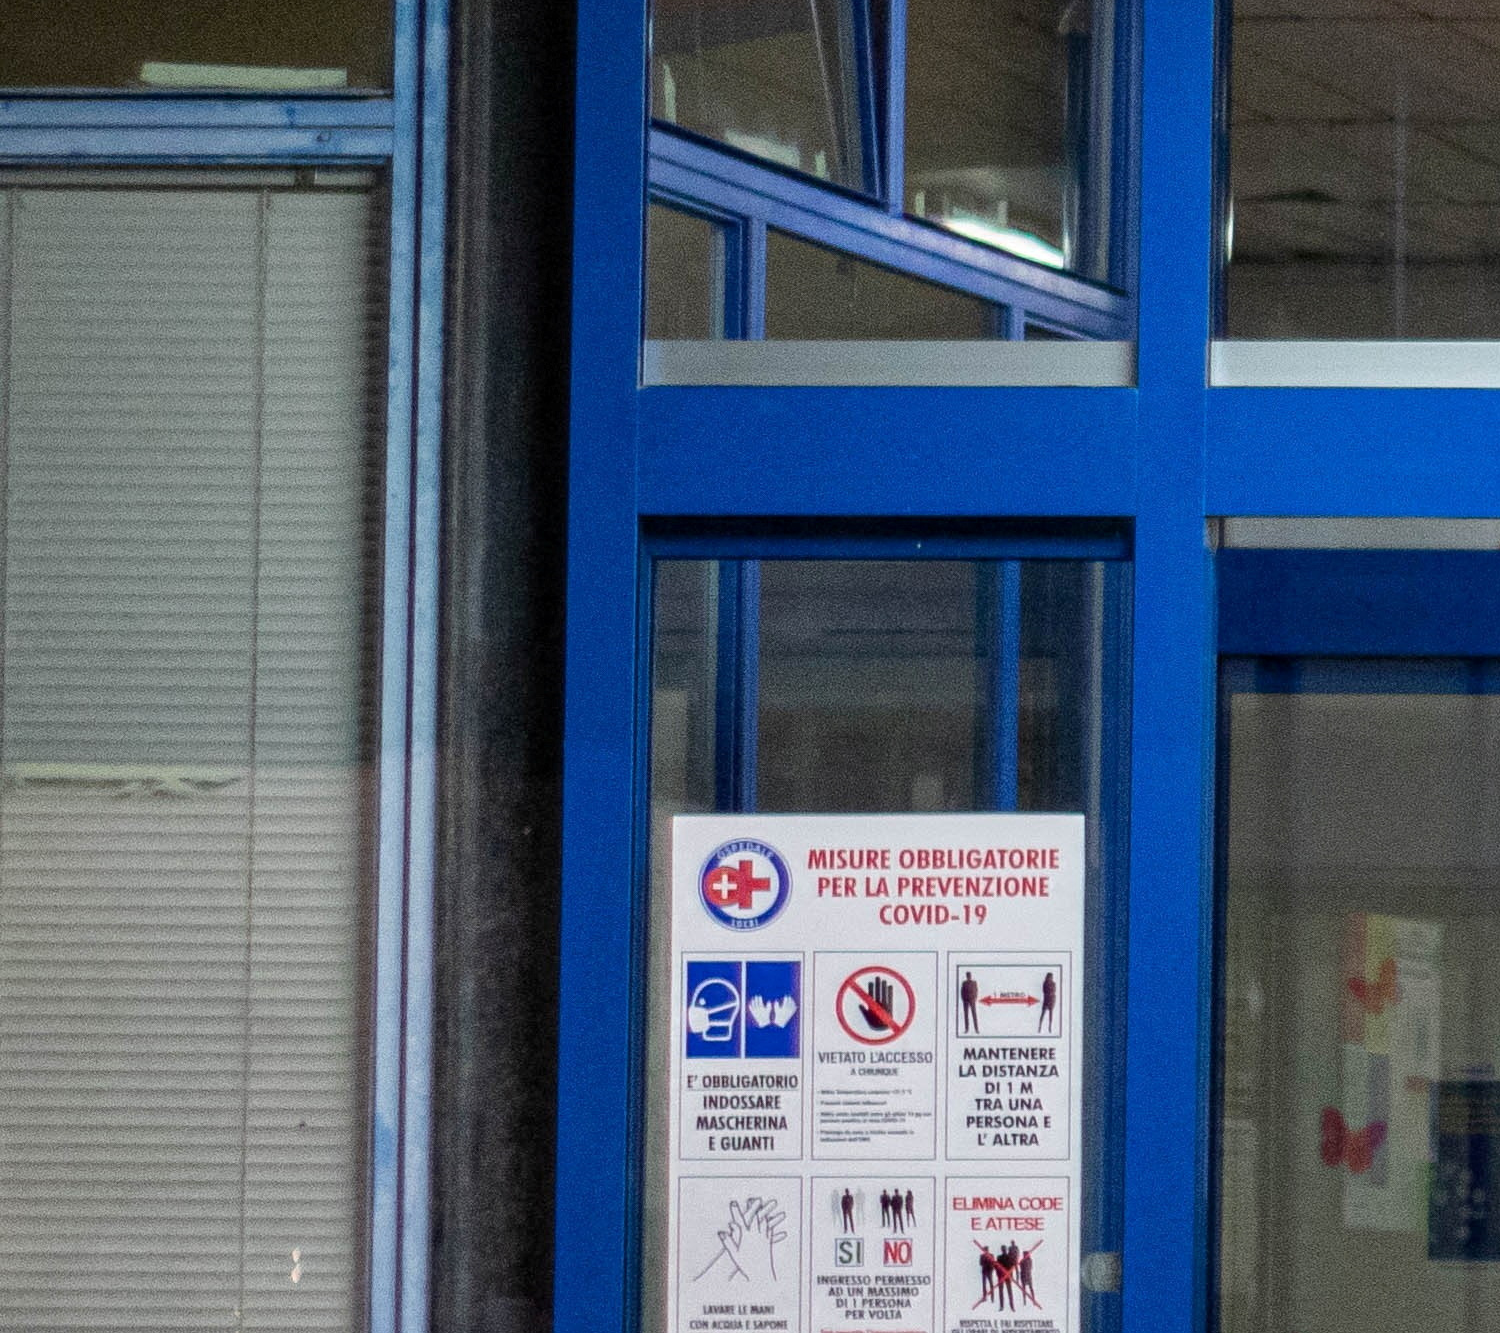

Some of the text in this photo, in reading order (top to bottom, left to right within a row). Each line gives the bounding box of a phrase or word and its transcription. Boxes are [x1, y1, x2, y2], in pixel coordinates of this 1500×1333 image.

[807, 849, 1060, 870] MISURE OBBLIGATORIE
[817, 877, 1049, 897] PER LA PREVENZIONE
[879, 904, 988, 925] COVID-19
[818, 1052, 933, 1064] VIETATO L'ACCESSO
[963, 1047, 1056, 1060] MANTENERE
[958, 1065, 1060, 1078] LA DISTANZA
[702, 1075, 799, 1089] OBBLIGATORIO
[984, 1082, 1034, 1095] DI 1 M
[703, 1095, 782, 1110] INDOSSARE
[975, 1098, 1043, 1111] TRA UNA
[696, 1116, 788, 1130] MASCHERINA
[966, 1116, 1052, 1128] PERSONA E
[708, 1136, 775, 1151] E GUANTI
[993, 1134, 1039, 1147] ALTRA
[953, 1197, 1064, 1211] ELIMINA CODE
[971, 1217, 1046, 1231] E ATTESE
[839, 1241, 862, 1264] SI
[883, 1241, 912, 1264] NO
[817, 1275, 931, 1286] INGRESSO PERMESSO
[828, 1287, 919, 1297] AD UN MASSIMO
[836, 1298, 848, 1308] DI
[862, 1298, 912, 1308] PERSONA
[703, 1305, 735, 1315] LAVARE
[750, 1305, 775, 1315] MANI
[845, 1310, 902, 1320] PER VOLTA
[689, 1319, 709, 1329] CON
[711, 1319, 742, 1329] ACQUA
[753, 1319, 788, 1329] SAPONE
